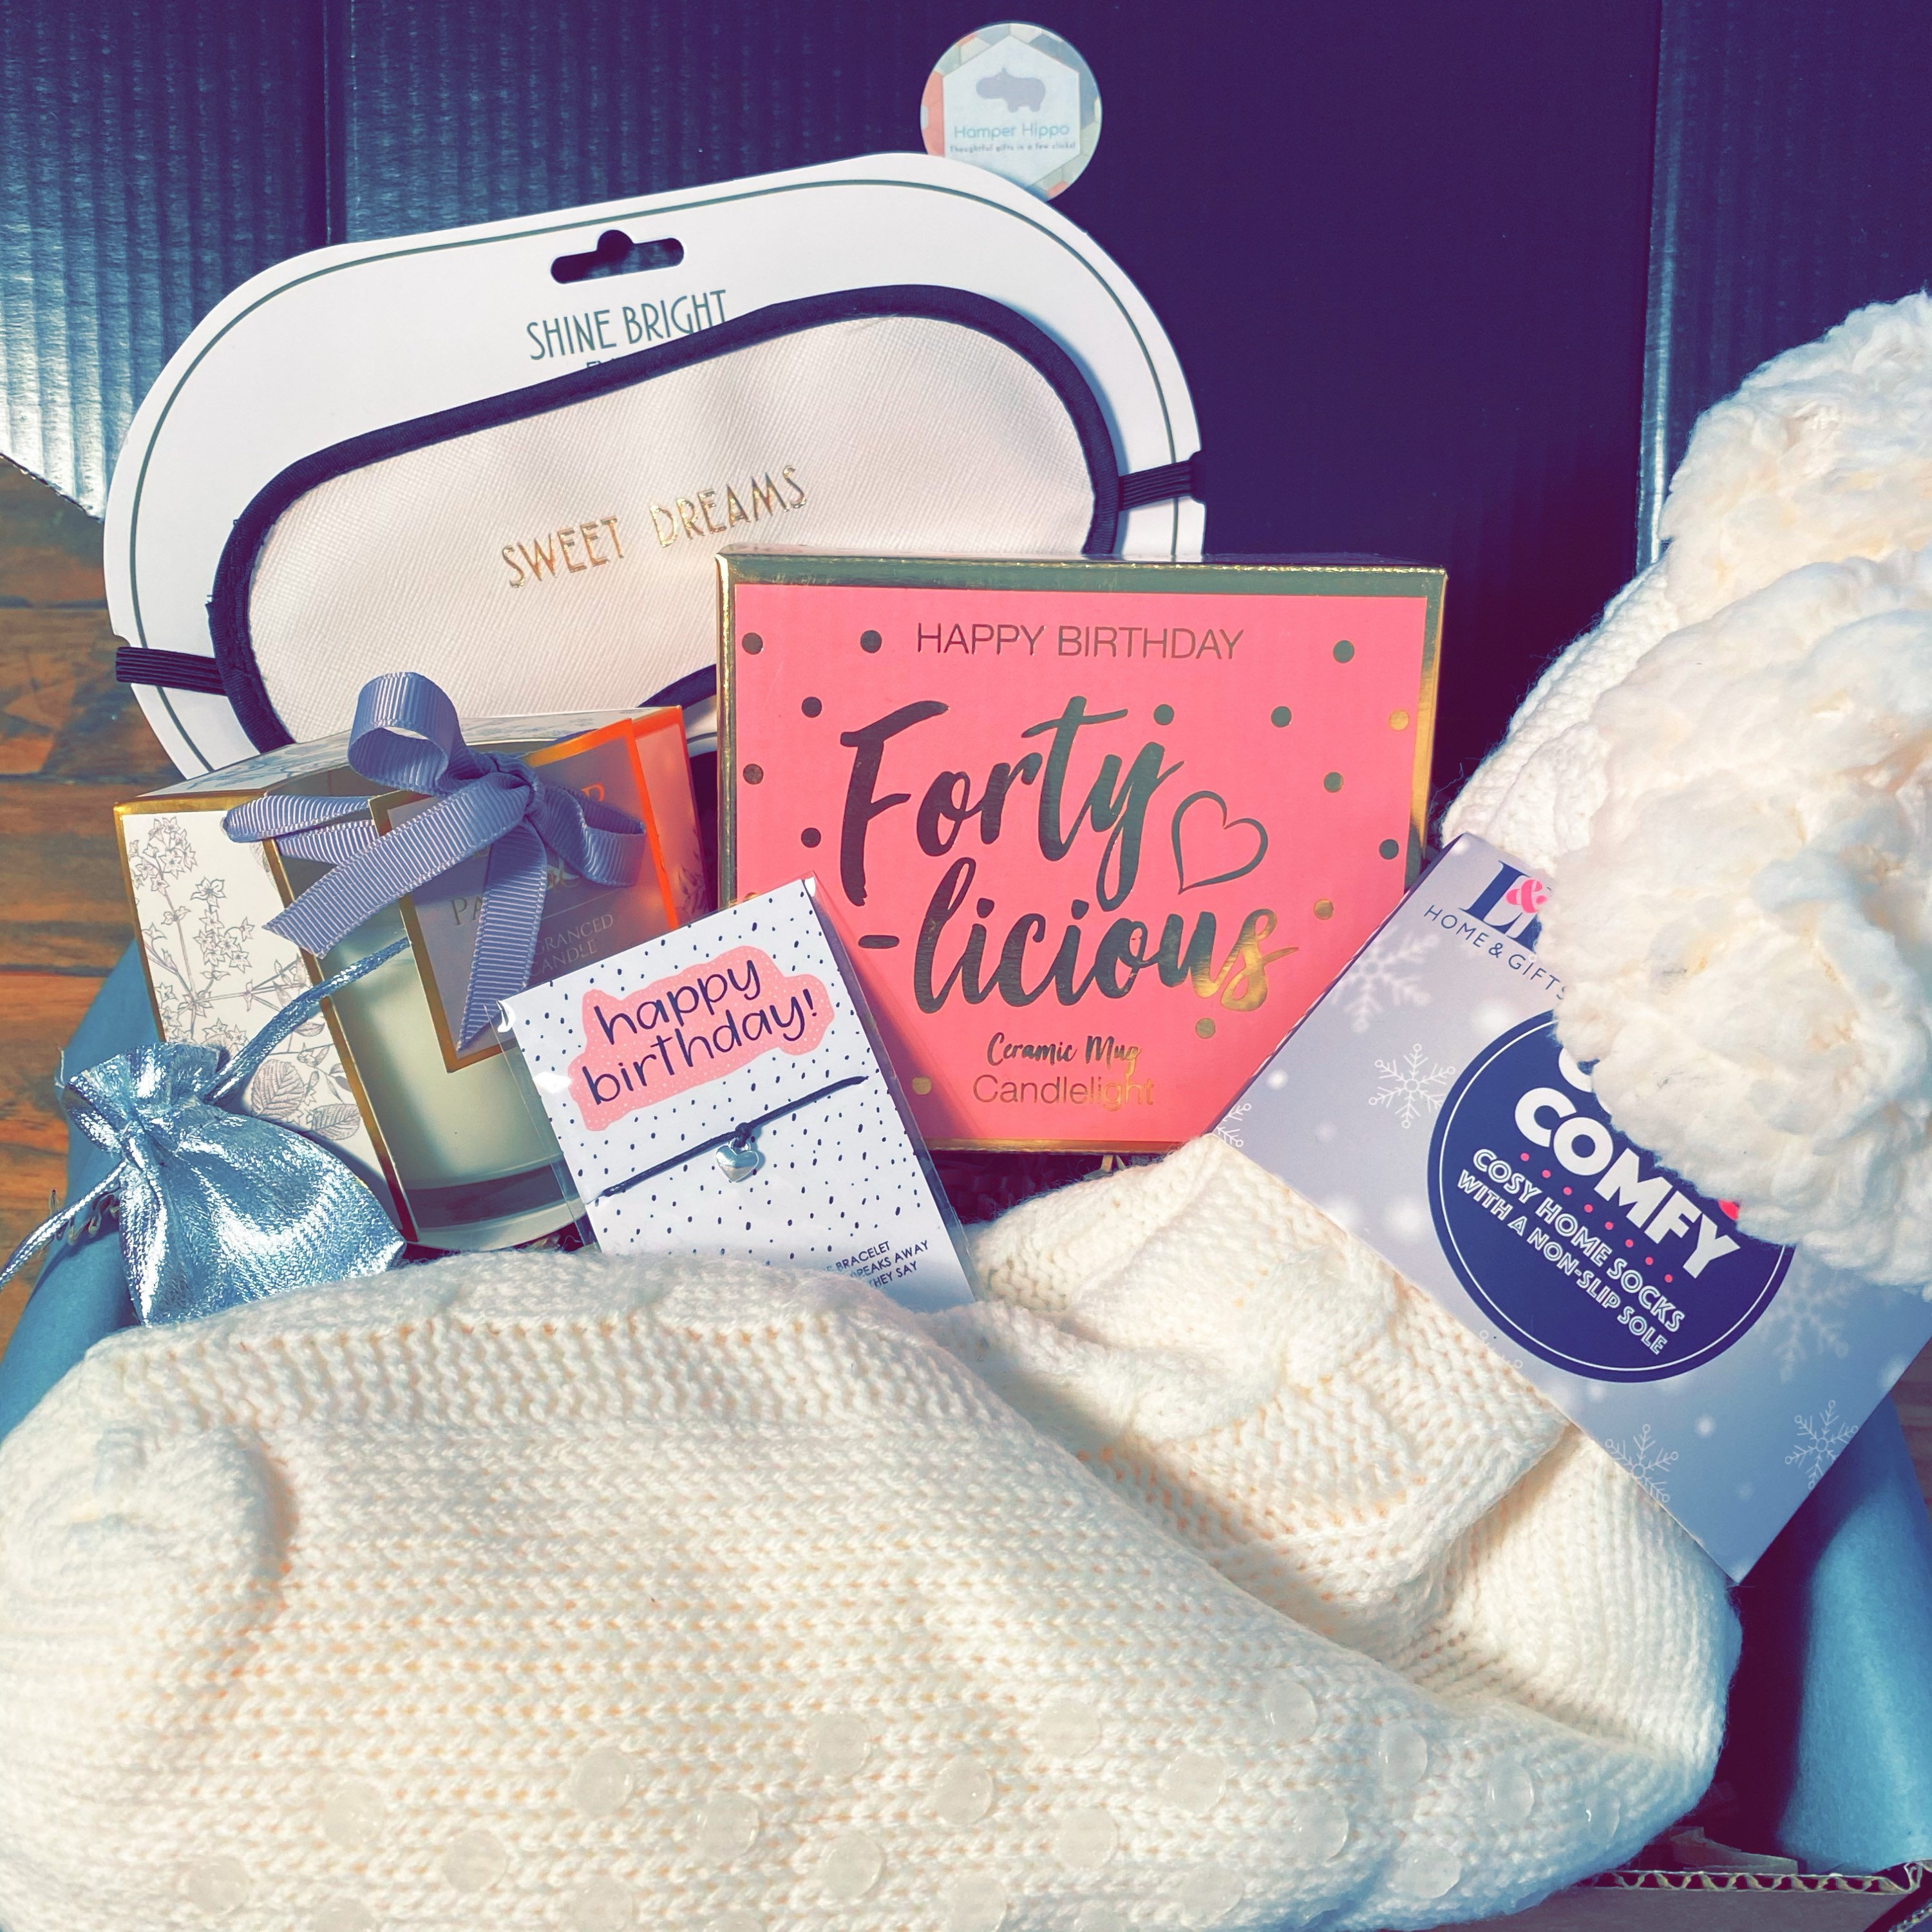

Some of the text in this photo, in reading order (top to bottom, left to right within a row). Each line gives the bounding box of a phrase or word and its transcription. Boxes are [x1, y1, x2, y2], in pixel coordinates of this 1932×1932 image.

[950, 144, 993, 153] Thoughtful
[996, 144, 1014, 152] gifts
[954, 122, 1070, 140] Hamper Hippo
[526, 289, 726, 360] SHINE BRIGHT
[501, 464, 807, 589] SWEET DREAMS
[917, 622, 1245, 661] HAPPY BIRTHDAY
[839, 694, 1186, 912] Forty
[1423, 905, 1489, 947] HOME
[1488, 942, 1503, 958] &
[594, 960, 761, 1045] happy
[582, 989, 817, 1106] birthday!
[987, 1032, 1143, 1076] Ceramic Mug
[972, 1074, 1155, 1112] Candlelight
[1514, 1086, 1741, 1279] COMFY
[835, 1240, 890, 1272] BRACELET
[895, 1240, 929, 1264] AWAY
[1457, 1169, 1668, 1355] WITH A NON-SLIP SOLE
[1473, 1148, 1685, 1332] COSY HOME SOCKS
[896, 1260, 917, 1278] SAY
